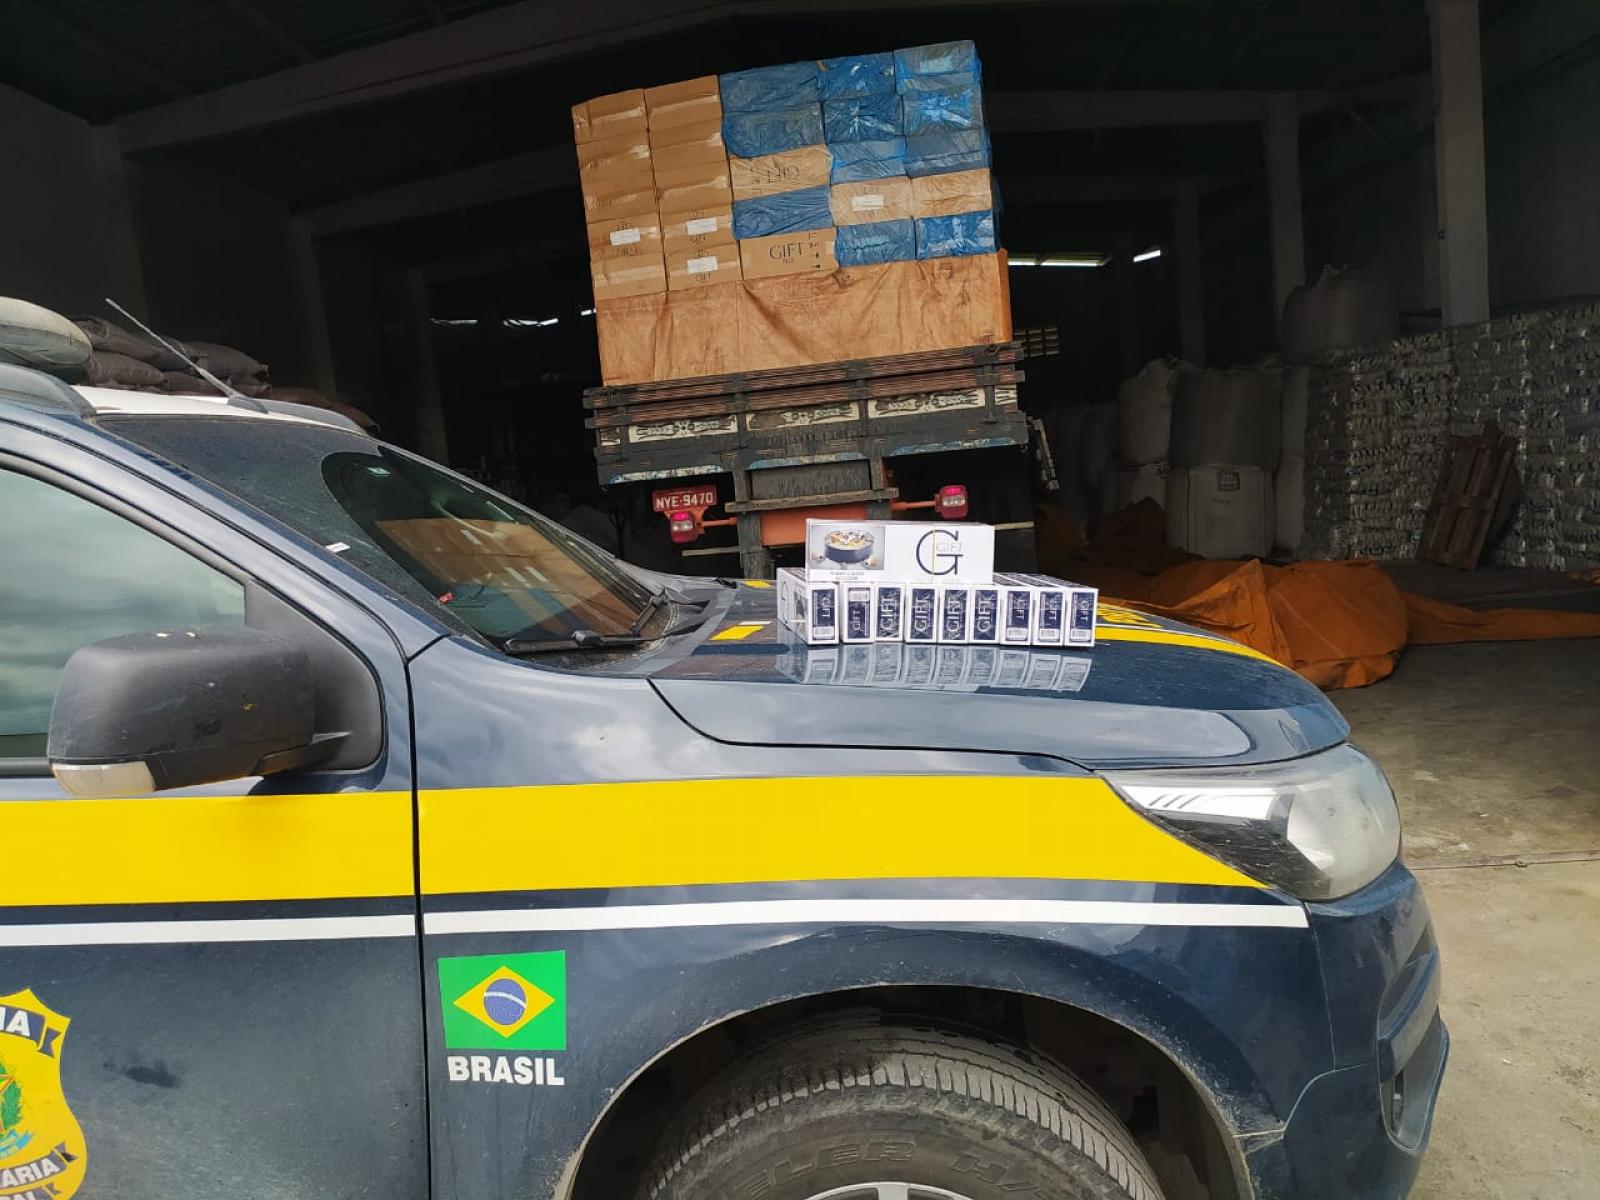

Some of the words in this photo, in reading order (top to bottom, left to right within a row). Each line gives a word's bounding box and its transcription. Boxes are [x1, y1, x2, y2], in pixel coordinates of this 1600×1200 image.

[769, 243, 805, 260] GIFT
[916, 529, 963, 576] G
[936, 542, 963, 552] GIFT
[852, 609, 861, 631] GIFT
[879, 595, 896, 631] GIFT
[914, 597, 931, 632] GIFT
[947, 597, 961, 633] GIFT
[976, 598, 991, 633] GIFT
[1080, 600, 1089, 622] GIFT
[447, 1055, 565, 1086] BRASIL
